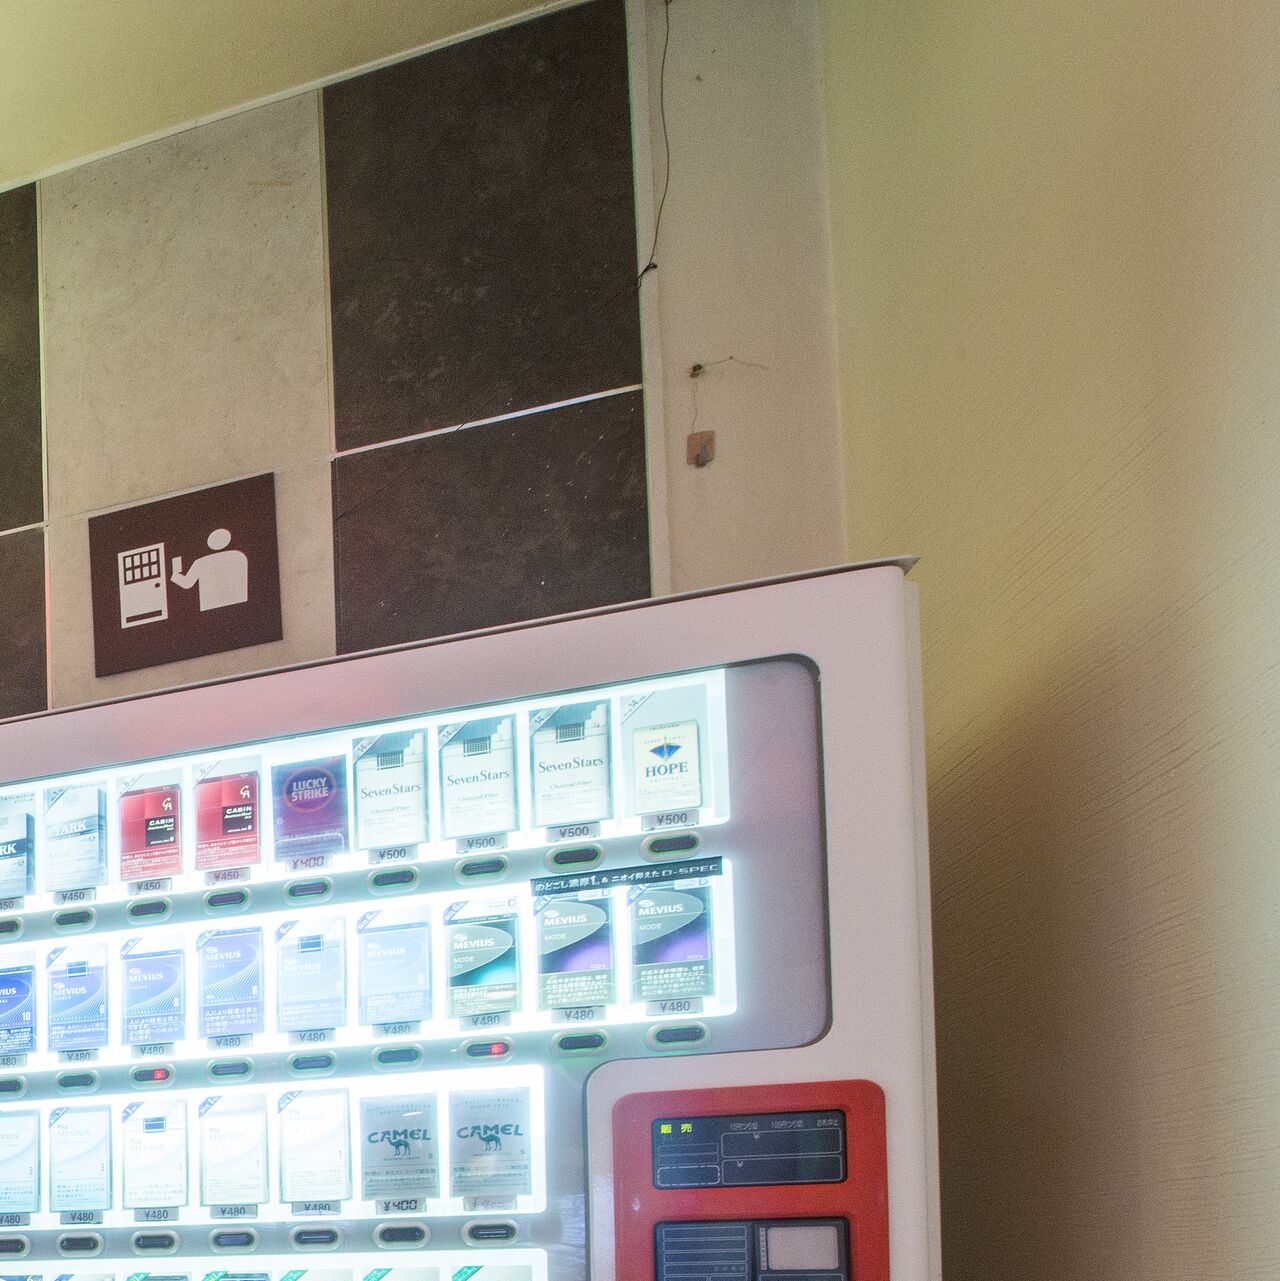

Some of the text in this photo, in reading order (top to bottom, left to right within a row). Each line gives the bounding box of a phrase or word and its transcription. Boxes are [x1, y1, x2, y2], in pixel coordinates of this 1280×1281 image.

[644, 760, 689, 779] HOPE
[292, 777, 328, 793] LUCKY
[290, 787, 329, 803] STRIKE
[225, 805, 253, 817] CABIN
[656, 812, 689, 827] ¥500
[559, 825, 590, 839] ¥500
[466, 837, 496, 849] ¥500
[378, 848, 407, 860] ¥500
[638, 903, 685, 918] MEVIUS
[544, 913, 588, 927] MEVIUS
[453, 936, 495, 949] MEVIUS
[366, 1127, 432, 1143] CAMEL
